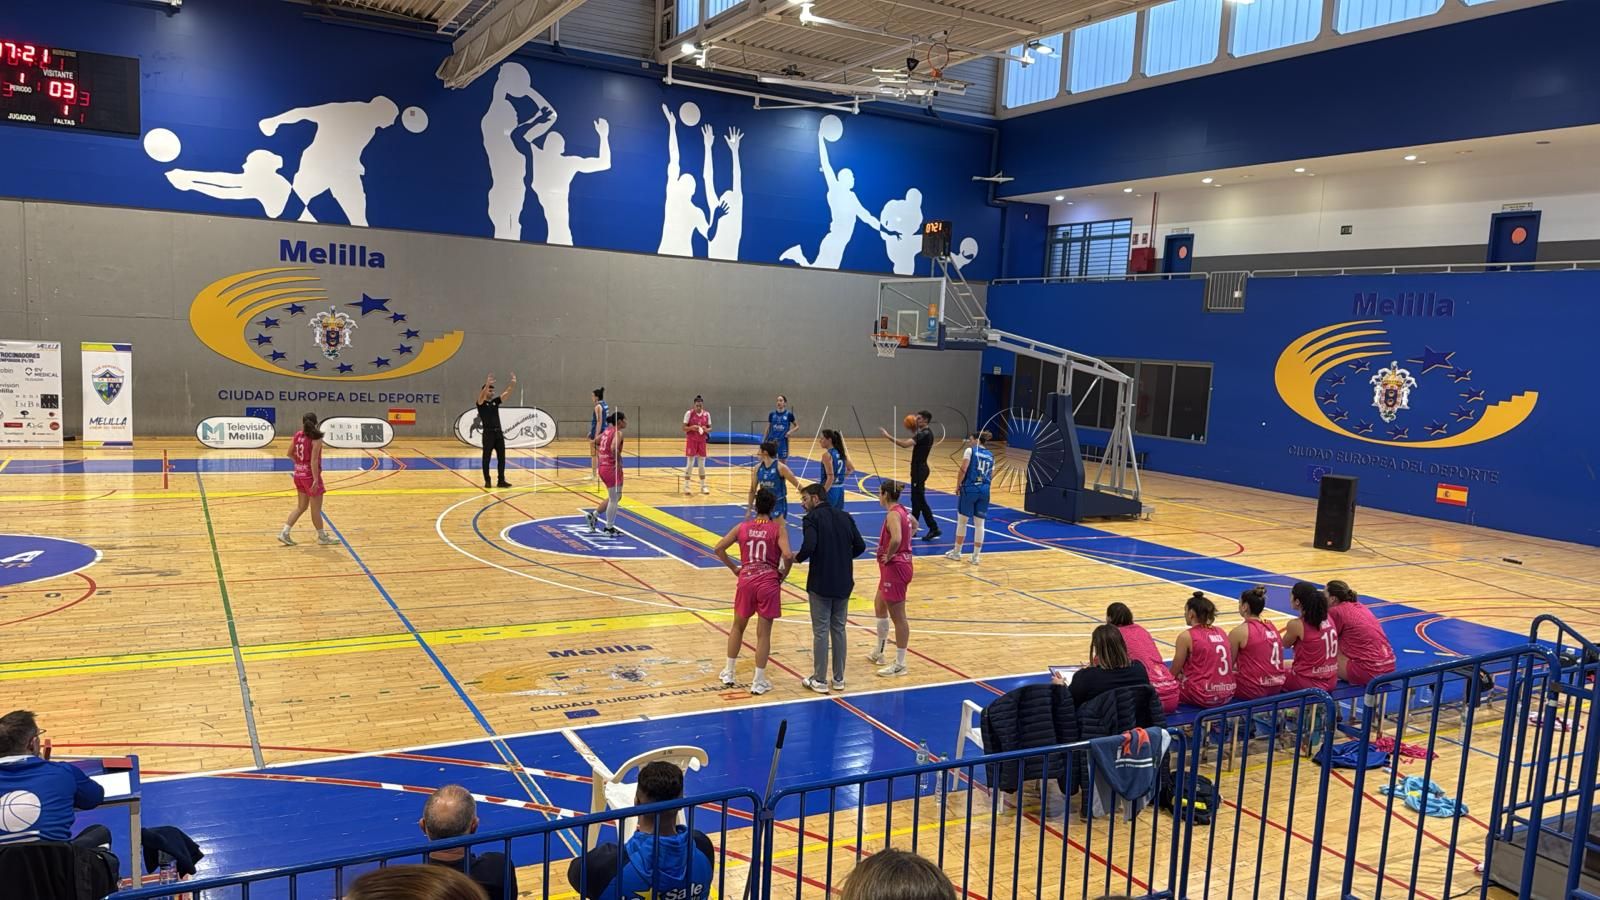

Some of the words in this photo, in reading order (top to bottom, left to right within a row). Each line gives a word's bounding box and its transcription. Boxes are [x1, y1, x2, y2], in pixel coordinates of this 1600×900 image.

[0, 43, 48, 62] 7:21
[42, 69, 74, 80] VISITANTE
[9, 84, 33, 93] PERIODO
[49, 81, 75, 99] 03
[8, 113, 36, 122] JUGADOR
[53, 118, 76, 126] FALTAS
[279, 239, 386, 268] Melilla
[1352, 290, 1456, 318] Melilla
[218, 389, 275, 401] CIUDAD
[278, 391, 345, 402] EUROPEA
[350, 392, 377, 403] DEL
[378, 393, 441, 404] DEPORTE
[89, 416, 128, 425] MELILLA
[227, 421, 273, 431] Televisión
[228, 432, 264, 441] Melilla
[295, 443, 305, 462] 13
[1288, 444, 1334, 461] CIUDAD
[1337, 450, 1397, 471] EUROPEA
[1400, 459, 1426, 474] DEL
[1430, 461, 1500, 484] DEPORTE
[746, 540, 767, 563] 10
[547, 643, 653, 659] Melilla
[1321, 628, 1338, 660] 16
[1215, 644, 1229, 676] 3
[1270, 641, 1281, 670] 4
[530, 699, 594, 713] CIUDAD
[597, 691, 670, 705] EUROPEA
[671, 687, 698, 697] DEL
